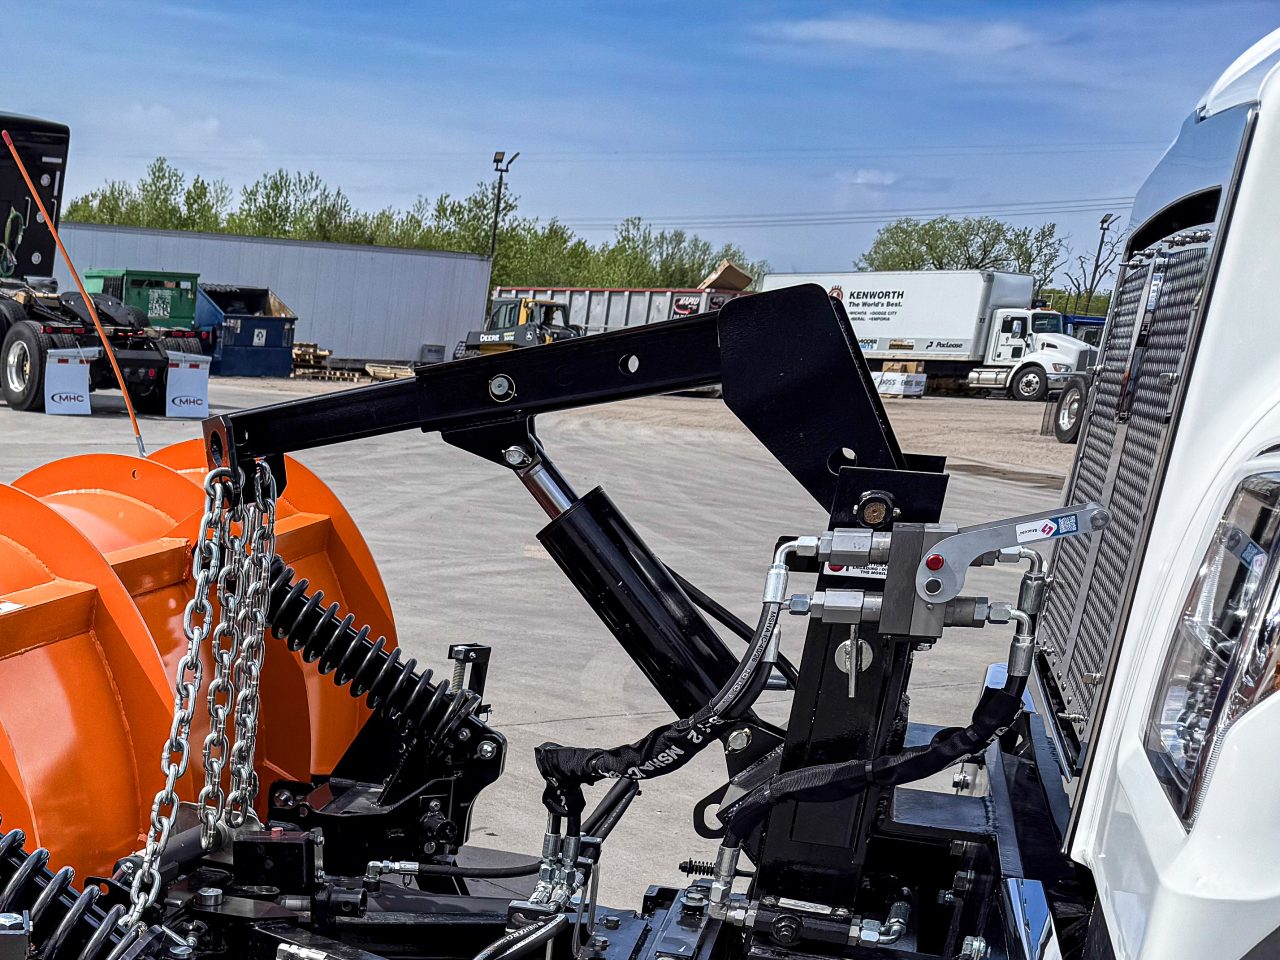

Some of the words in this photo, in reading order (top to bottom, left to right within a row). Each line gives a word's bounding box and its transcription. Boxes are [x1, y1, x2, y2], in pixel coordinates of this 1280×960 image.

[849, 291, 904, 299] KENWORTH
[480, 334, 500, 342] DEERE
[59, 394, 84, 403] MHC
[179, 398, 204, 406] MHC
[764, 610, 777, 634] MSHA
[639, 744, 685, 772] MSHA
